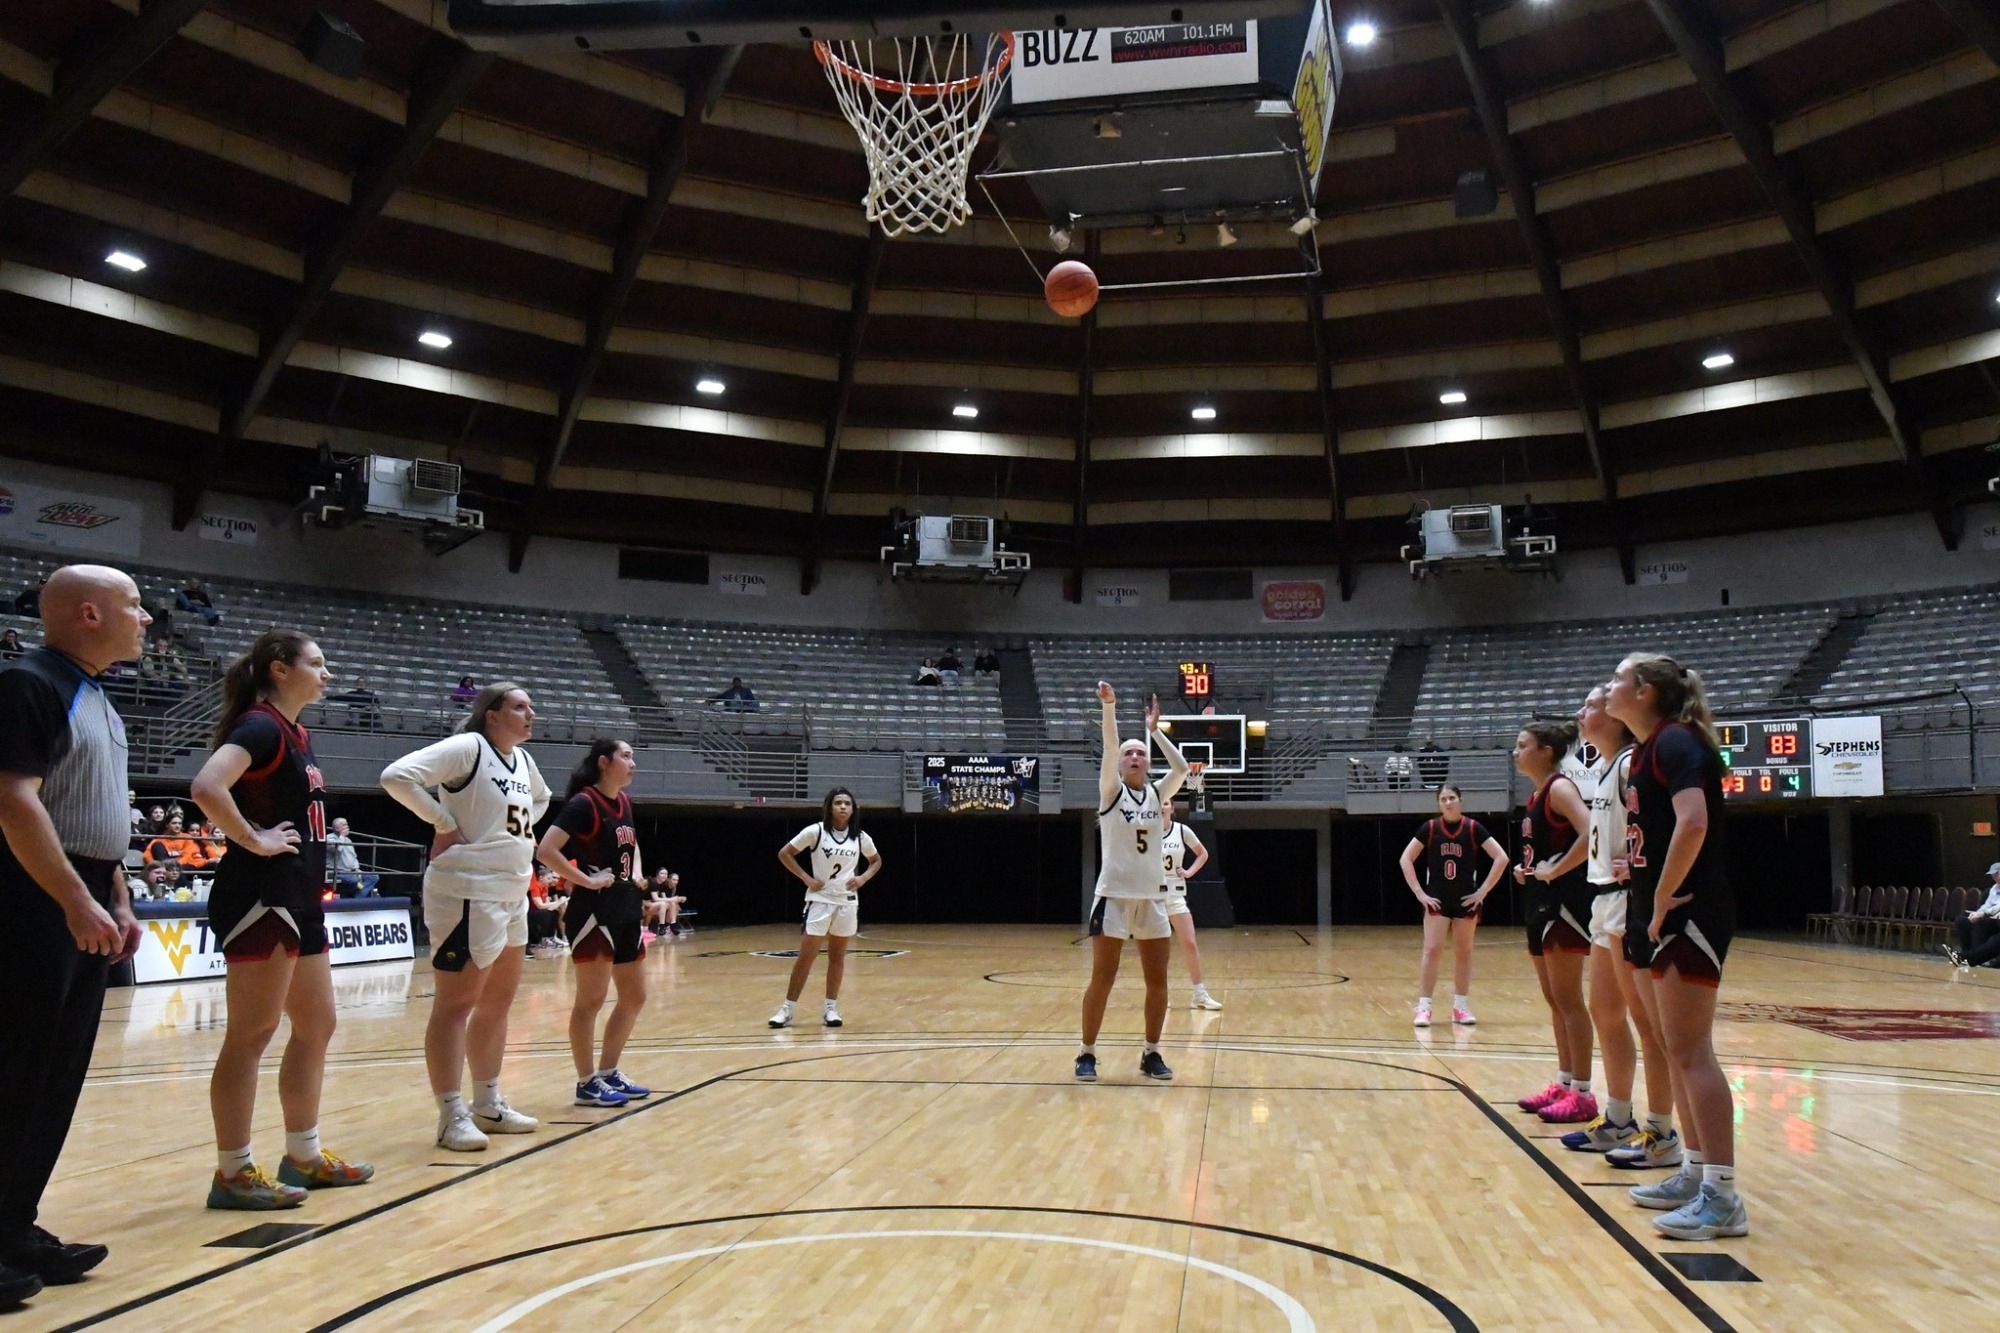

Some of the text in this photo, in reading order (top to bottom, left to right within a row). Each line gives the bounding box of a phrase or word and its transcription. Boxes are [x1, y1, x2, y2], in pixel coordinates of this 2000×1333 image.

[1124, 23, 1233, 45] 620AM 101.1FM
[1023, 27, 1099, 67] BUZZ
[200, 516, 257, 532] SECTION
[224, 529, 232, 539] 6
[1640, 562, 1687, 575] SECTION
[721, 574, 766, 584] SECTION
[740, 584, 747, 592] 7
[1097, 587, 1139, 597] SECTION
[1180, 663, 1207, 674] 43.1
[1185, 674, 1209, 694] 30
[1763, 723, 1798, 733] VISITOR
[1770, 735, 1796, 755] 83
[1816, 741, 1880, 756] STEPHENS
[927, 757, 946, 767] 2025
[974, 766, 1006, 774] CHAMPS
[1760, 776, 1772, 792] 0
[1788, 775, 1800, 790] 4
[506, 804, 533, 839] 52
[1136, 811, 1159, 820] TECH
[616, 825, 636, 848] RIO
[1136, 829, 1148, 854] 5
[834, 848, 857, 857] TECH
[1441, 842, 1462, 857] RIO
[620, 852, 631, 881] 3
[829, 863, 842, 880] 2
[1444, 859, 1457, 880] 0
[364, 922, 408, 947] BEARS
